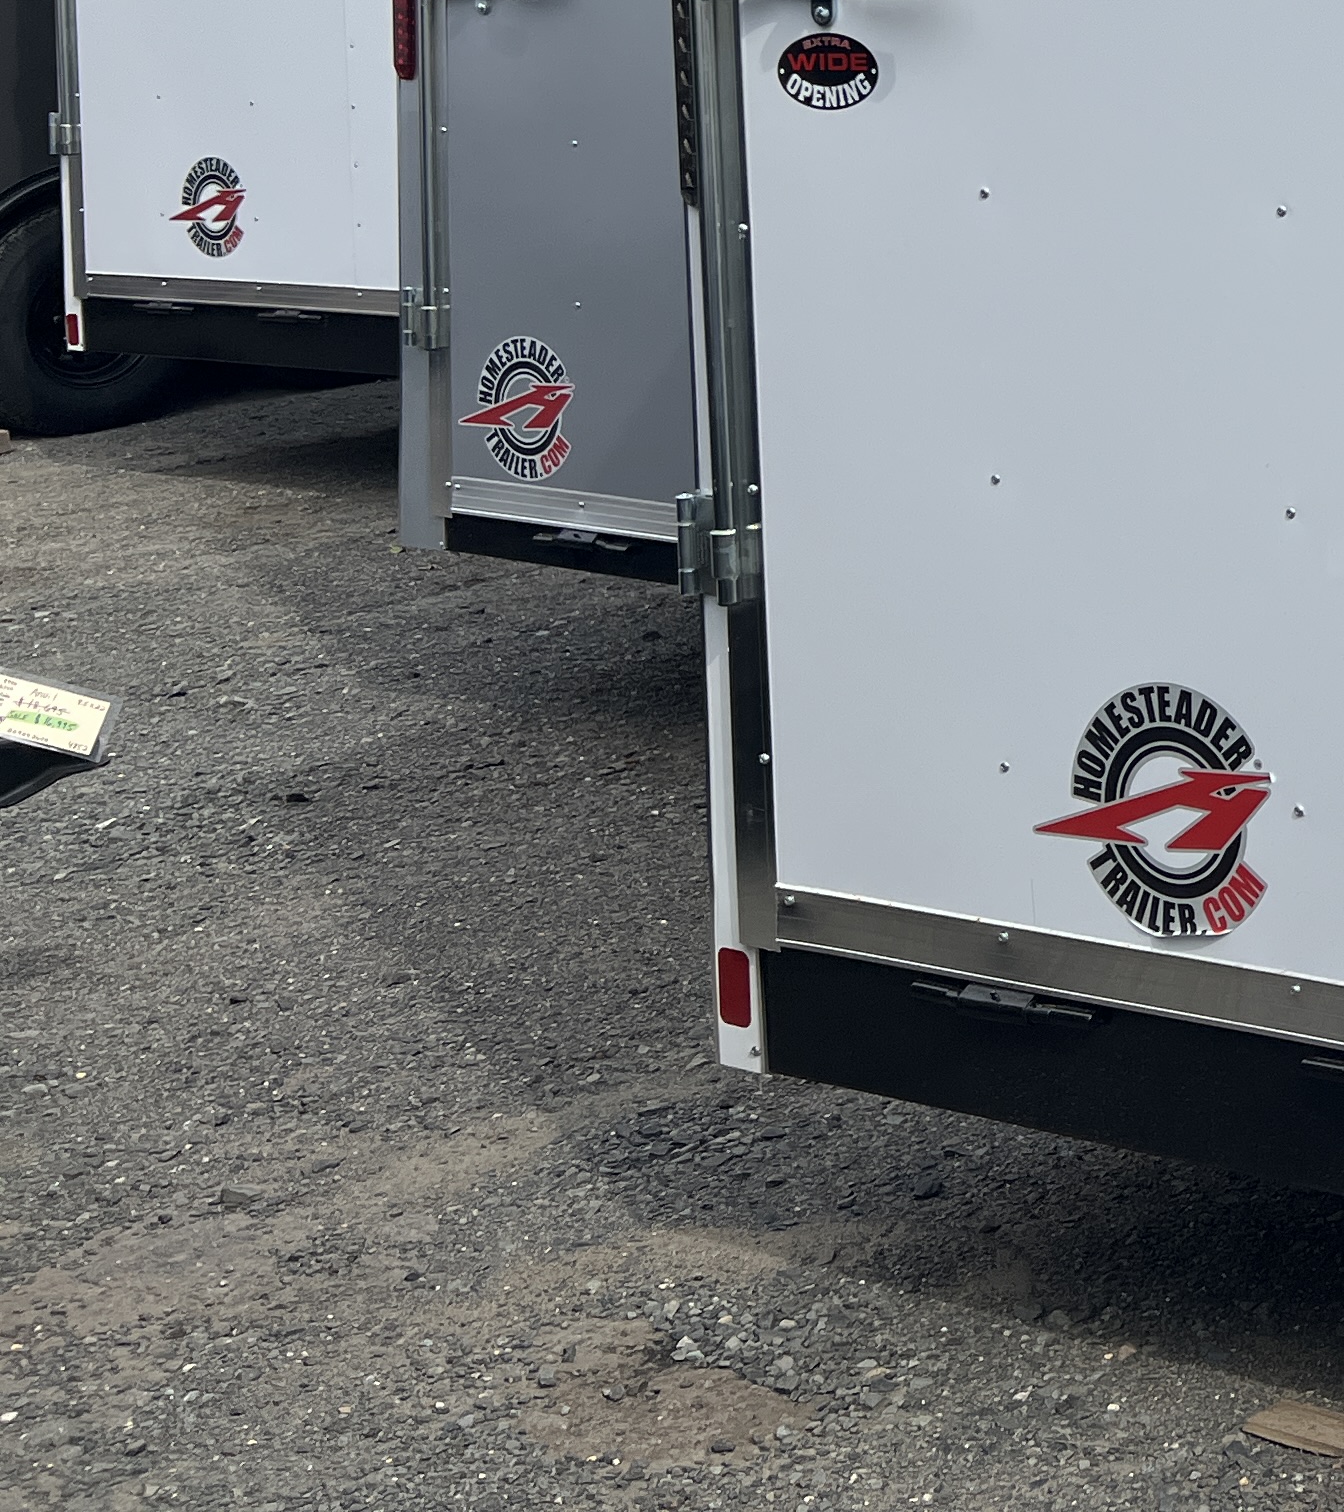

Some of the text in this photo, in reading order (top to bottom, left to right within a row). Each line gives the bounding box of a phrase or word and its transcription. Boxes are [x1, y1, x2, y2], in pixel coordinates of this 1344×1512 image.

[786, 52, 869, 71] WIDE
[802, 36, 852, 50] EXTRA
[785, 72, 872, 108] OPENING
[182, 156, 241, 206] HOMESTEADER
[478, 337, 566, 405] HOMESTEADER
[485, 428, 570, 480] TRAILER.COM
[1073, 685, 1254, 803] HOMESTEADER
[1089, 843, 1266, 935] TRAILER.COM
